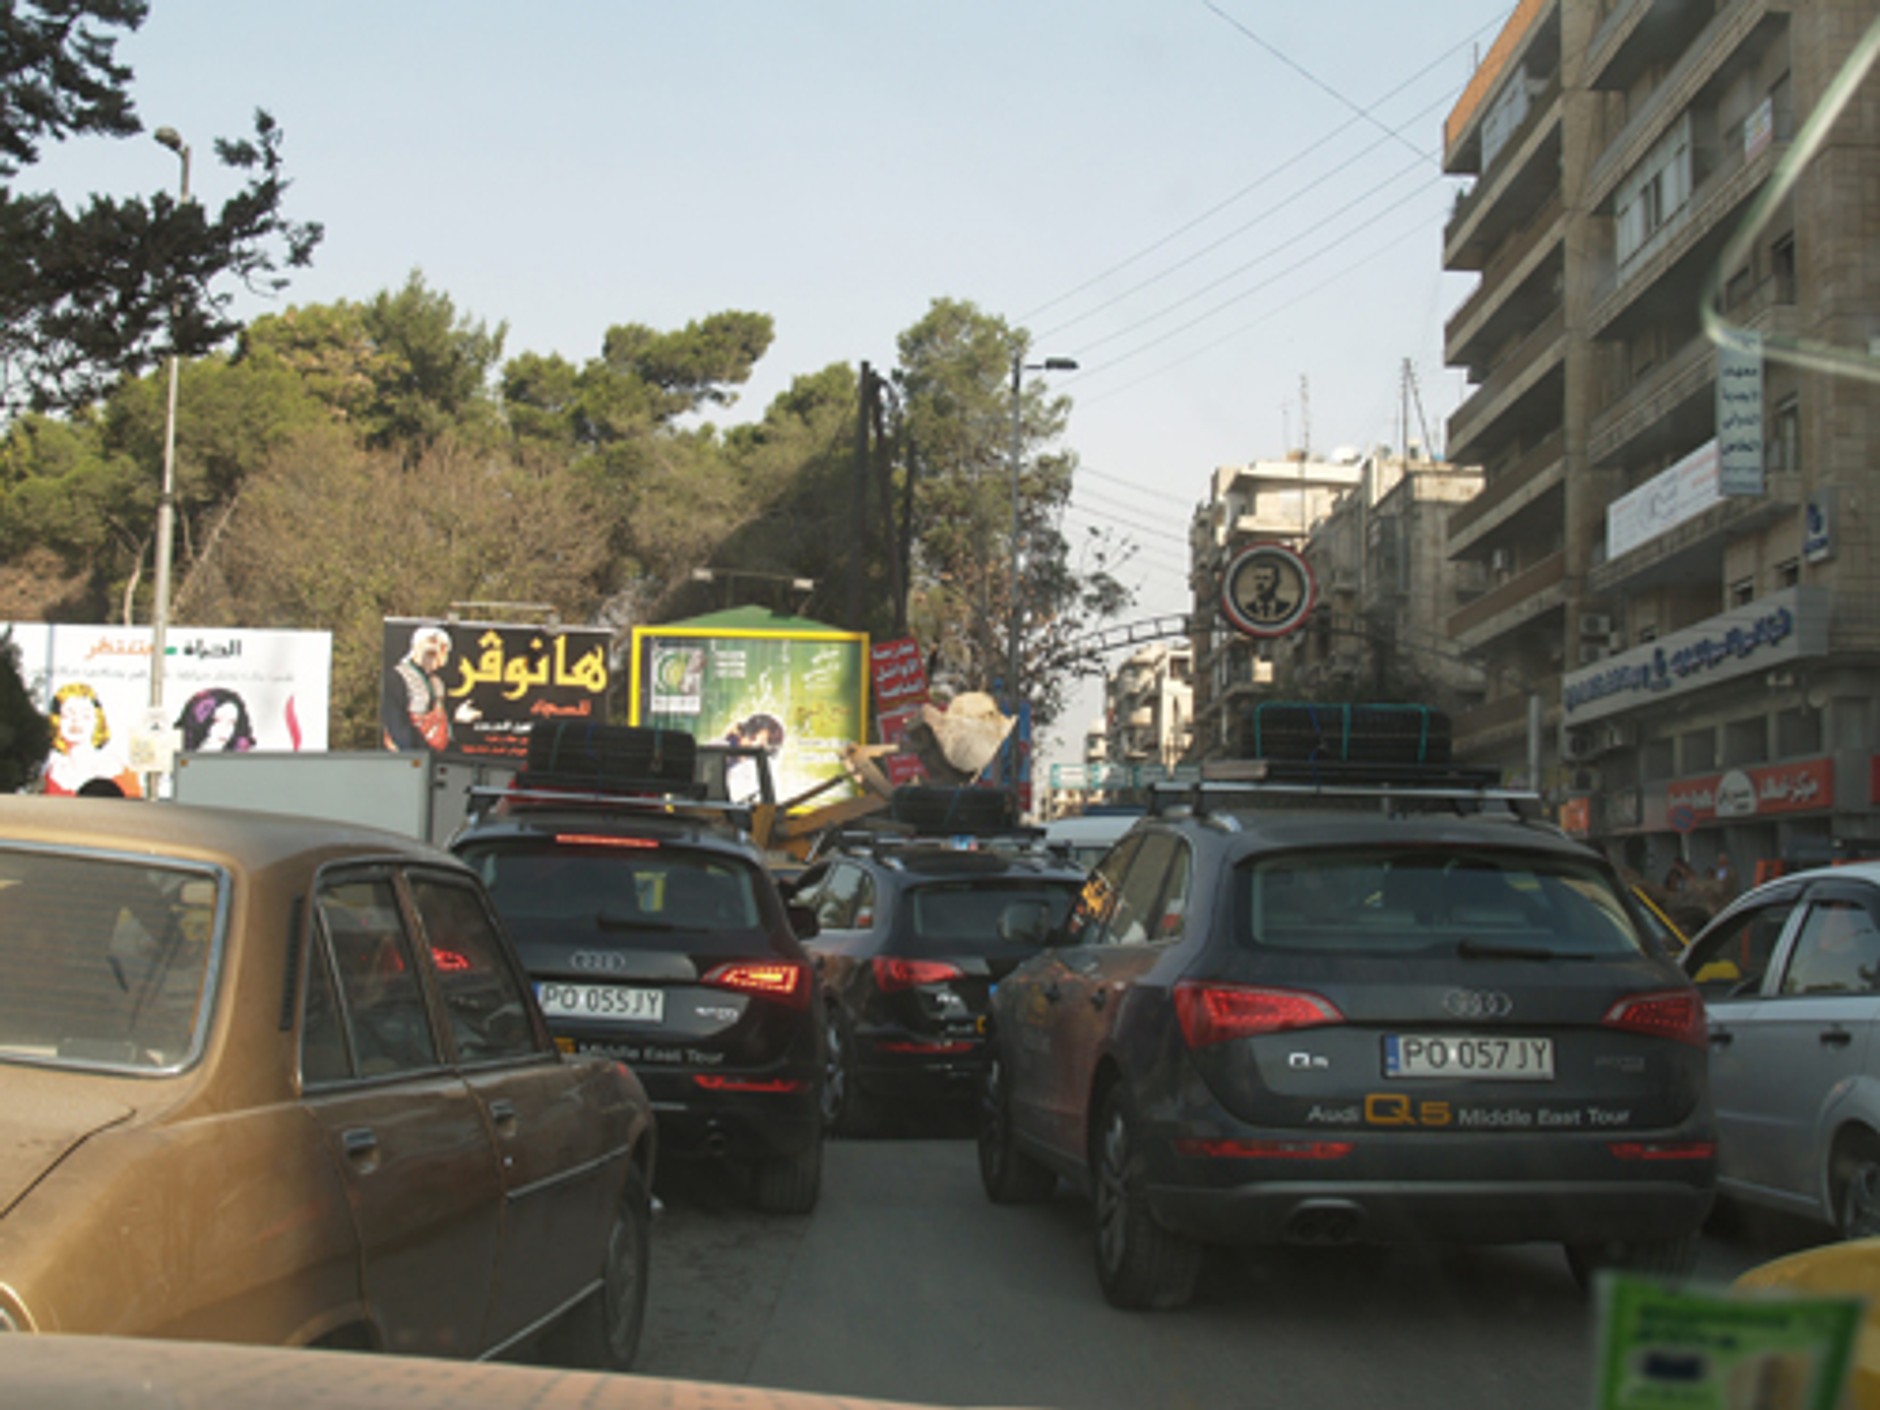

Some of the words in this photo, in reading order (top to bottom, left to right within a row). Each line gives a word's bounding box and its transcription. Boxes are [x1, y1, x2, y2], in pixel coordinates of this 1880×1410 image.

[448, 630, 607, 699] هانوڤر
[545, 984, 578, 1010] PO
[1402, 1038, 1448, 1070] PO
[1457, 1039, 1548, 1070] 057JY
[1306, 1104, 1361, 1123] Audi
[1364, 1092, 1452, 1126] Q5
[1458, 1107, 1532, 1126] Middle
[1537, 1107, 1581, 1125] East
[1585, 1106, 1631, 1125] Tour
